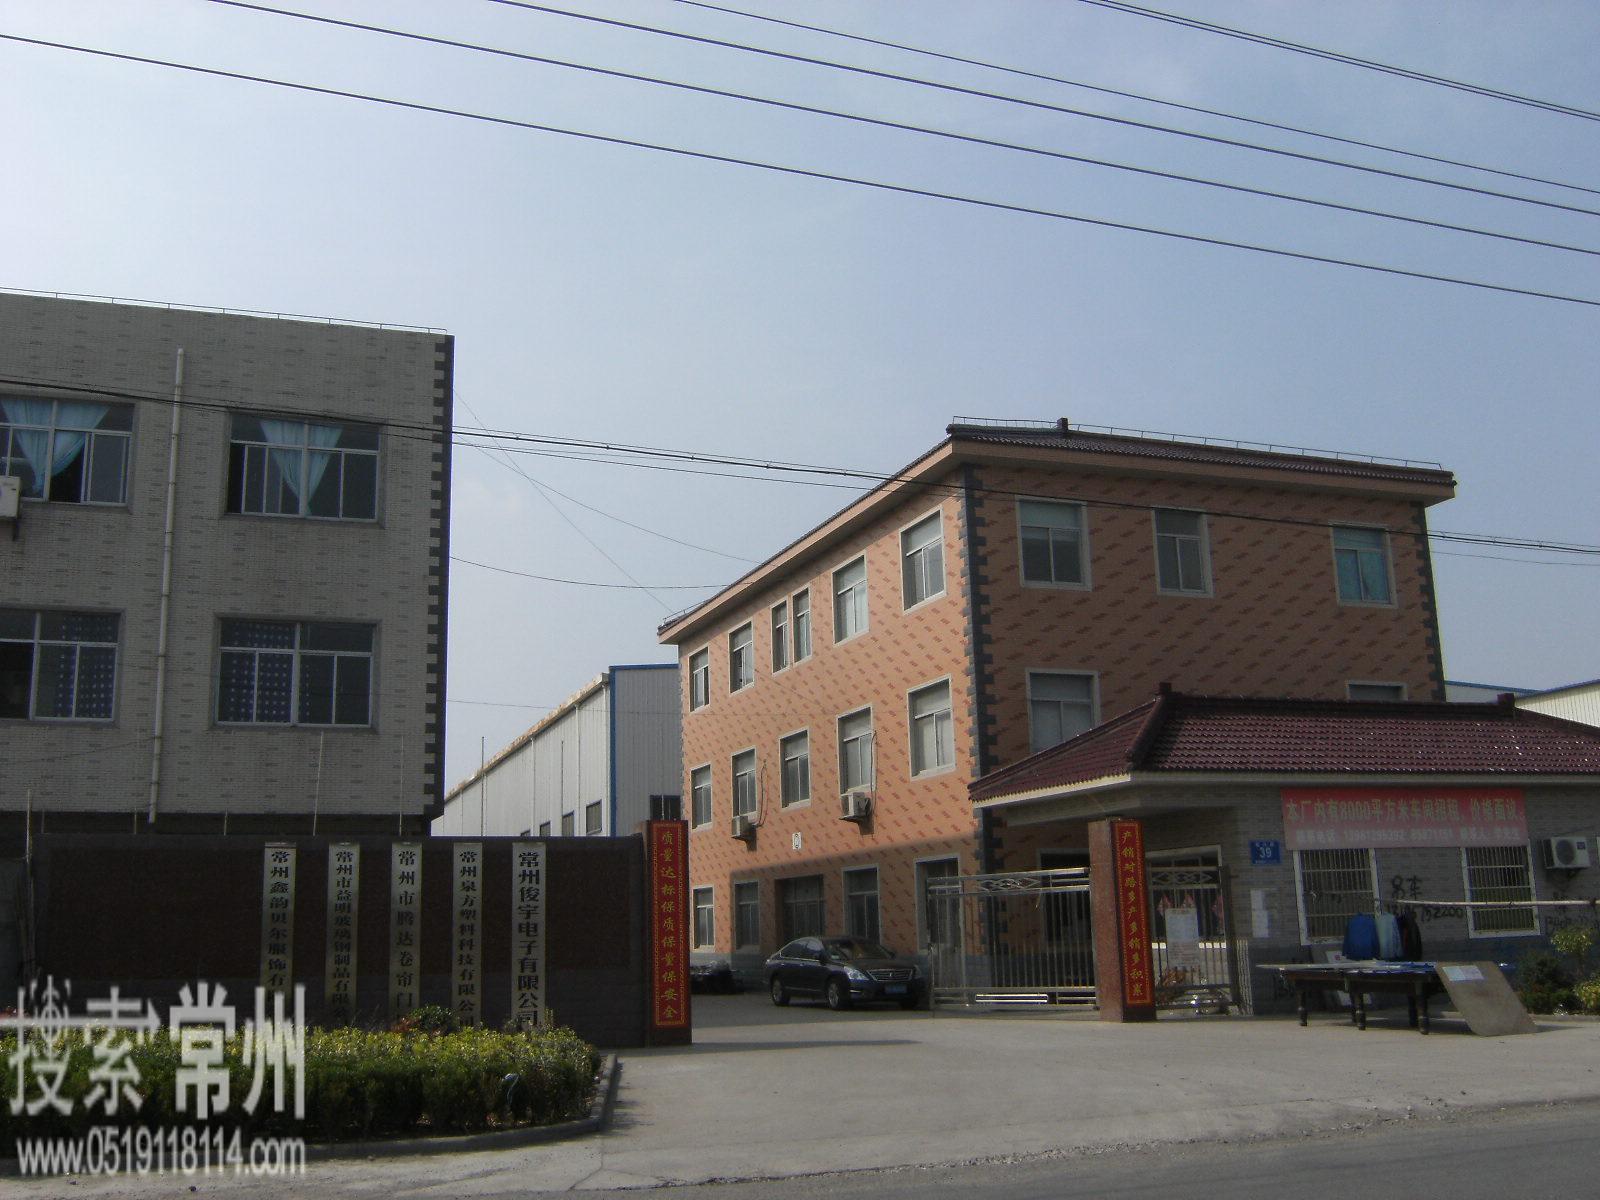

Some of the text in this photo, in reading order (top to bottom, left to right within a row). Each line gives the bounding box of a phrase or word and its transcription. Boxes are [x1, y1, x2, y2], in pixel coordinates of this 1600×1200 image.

[396, 850, 416, 1020] 常州市腾达卷帘门
[661, 831, 677, 1019] 质量达标保质保量保安全
[1260, 847, 1272, 858] 39
